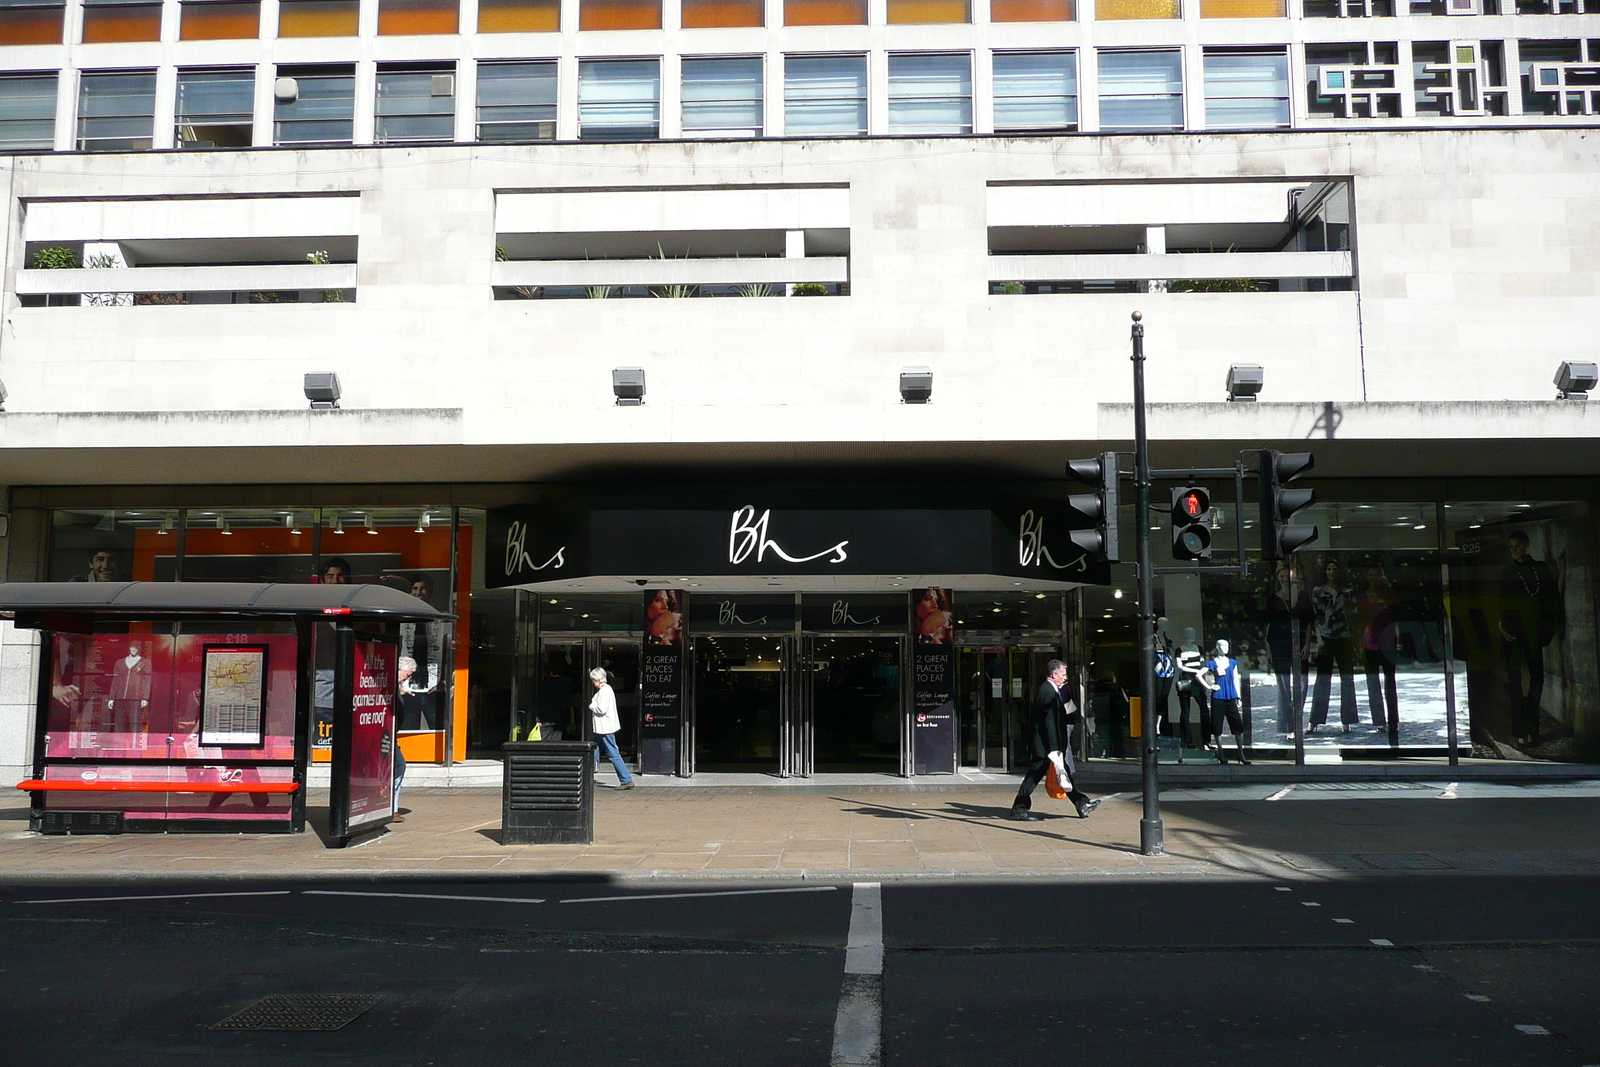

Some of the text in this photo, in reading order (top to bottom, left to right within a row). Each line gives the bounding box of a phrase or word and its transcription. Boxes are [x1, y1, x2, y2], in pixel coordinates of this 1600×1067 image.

[729, 503, 849, 565] Bhs
[1019, 509, 1088, 572] Bhs
[505, 520, 566, 576] Bhs
[1462, 543, 1481, 554] £25
[718, 600, 768, 625] Bhs
[831, 600, 881, 625] Bhs
[224, 633, 249, 644] £18
[364, 654, 385, 670] All the
[645, 655, 678, 664] 2 GREAT
[916, 655, 949, 663] 2 GREAT
[645, 665, 673, 673] PLACES
[916, 665, 945, 673] PLACES
[359, 671, 389, 692] beautiful
[645, 674, 673, 683] TO EAT
[916, 674, 944, 682] TO EAT
[352, 690, 393, 712] games under
[645, 691, 661, 702] Coffee
[916, 691, 932, 702] Coffee
[359, 707, 387, 727] one roof
[318, 720, 333, 737] tr
